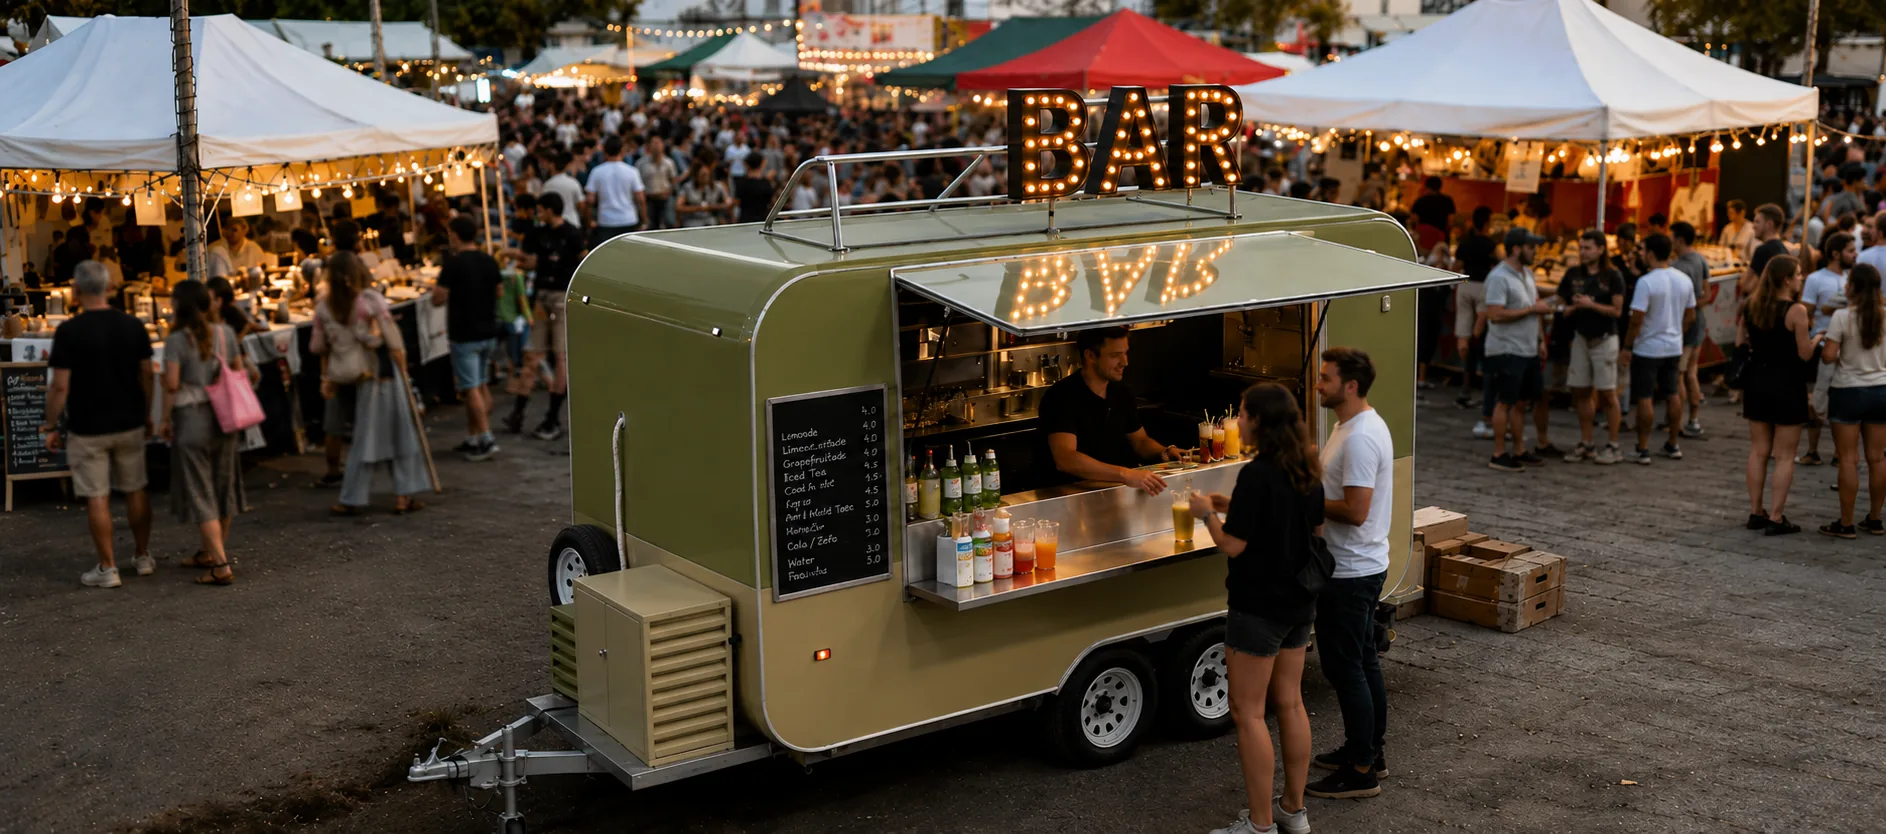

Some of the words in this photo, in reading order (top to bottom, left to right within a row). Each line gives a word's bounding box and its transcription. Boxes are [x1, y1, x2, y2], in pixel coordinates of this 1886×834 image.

[1007, 84, 1244, 201] BAR
[862, 420, 877, 430] 4.0
[784, 471, 805, 483] Iced
[808, 468, 827, 478] Tea
[864, 485, 879, 495] 4.5
[865, 498, 880, 508] 5.0
[787, 540, 808, 551] Cola
[866, 543, 881, 554] 3.0
[788, 557, 815, 568] Water
[866, 554, 881, 565] 5.0
